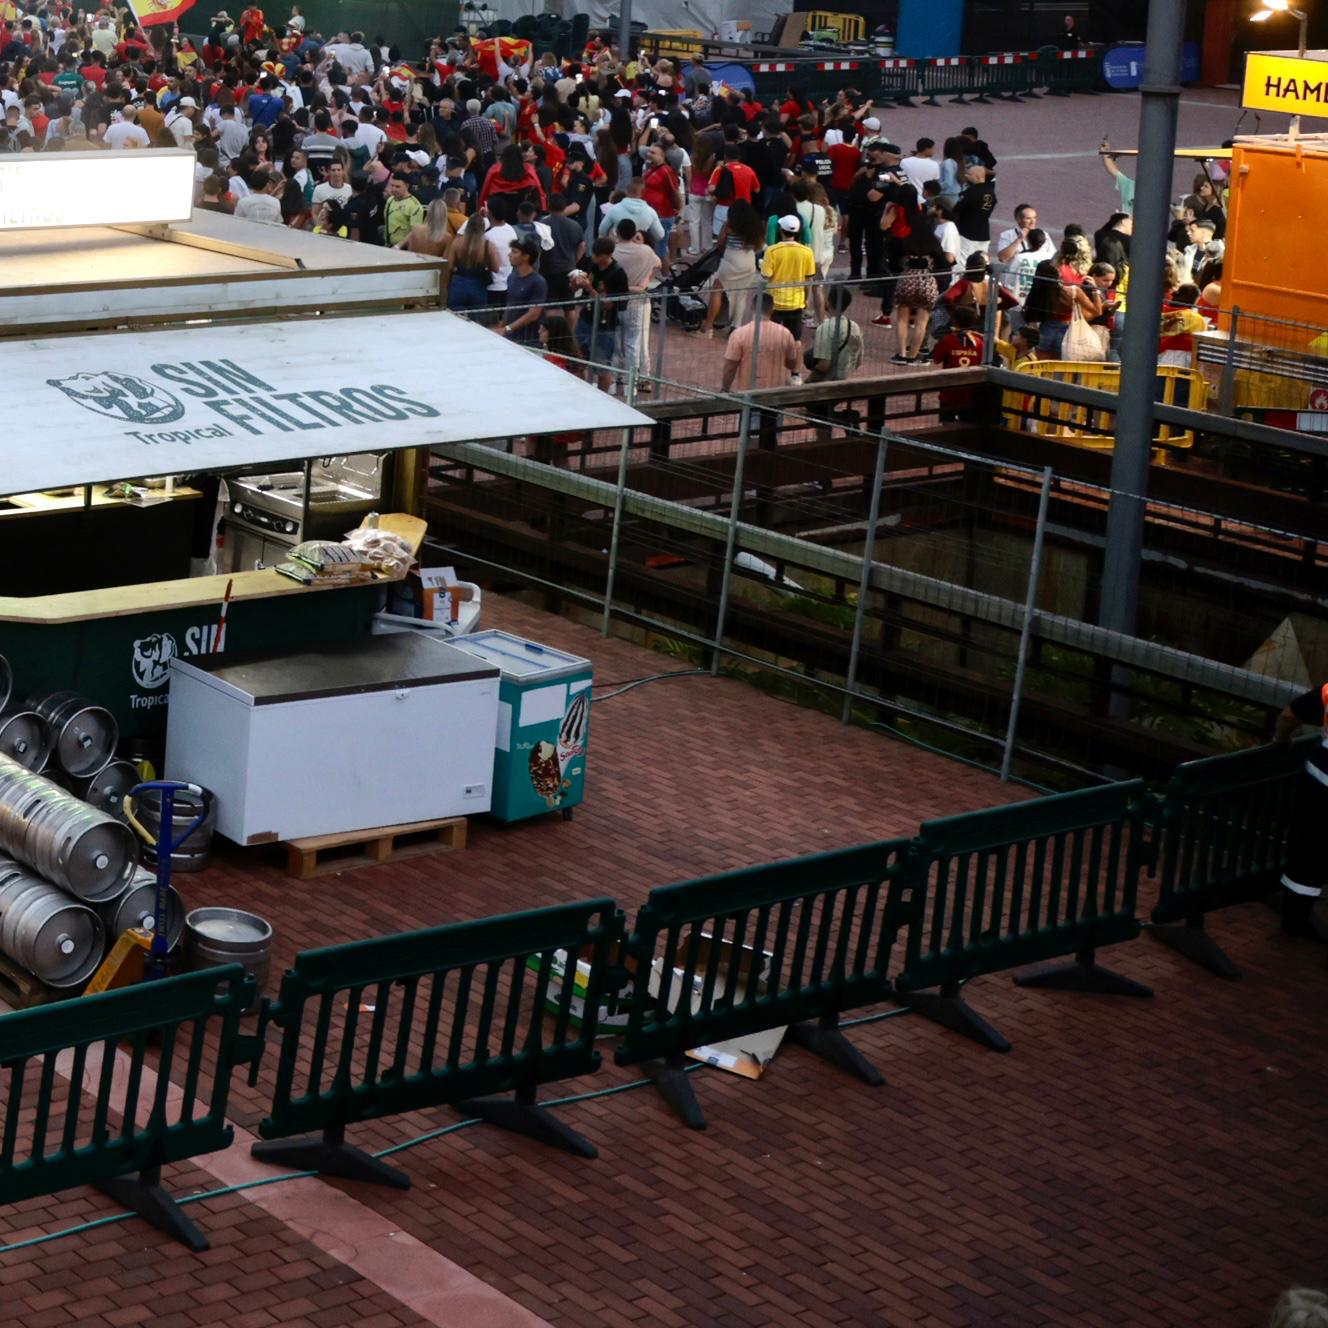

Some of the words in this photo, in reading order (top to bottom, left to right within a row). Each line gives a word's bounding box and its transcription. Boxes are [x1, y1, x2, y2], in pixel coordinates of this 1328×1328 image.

[149, 359, 278, 398] SIN
[202, 384, 442, 436] FILTROS
[124, 423, 234, 446] Tropical
